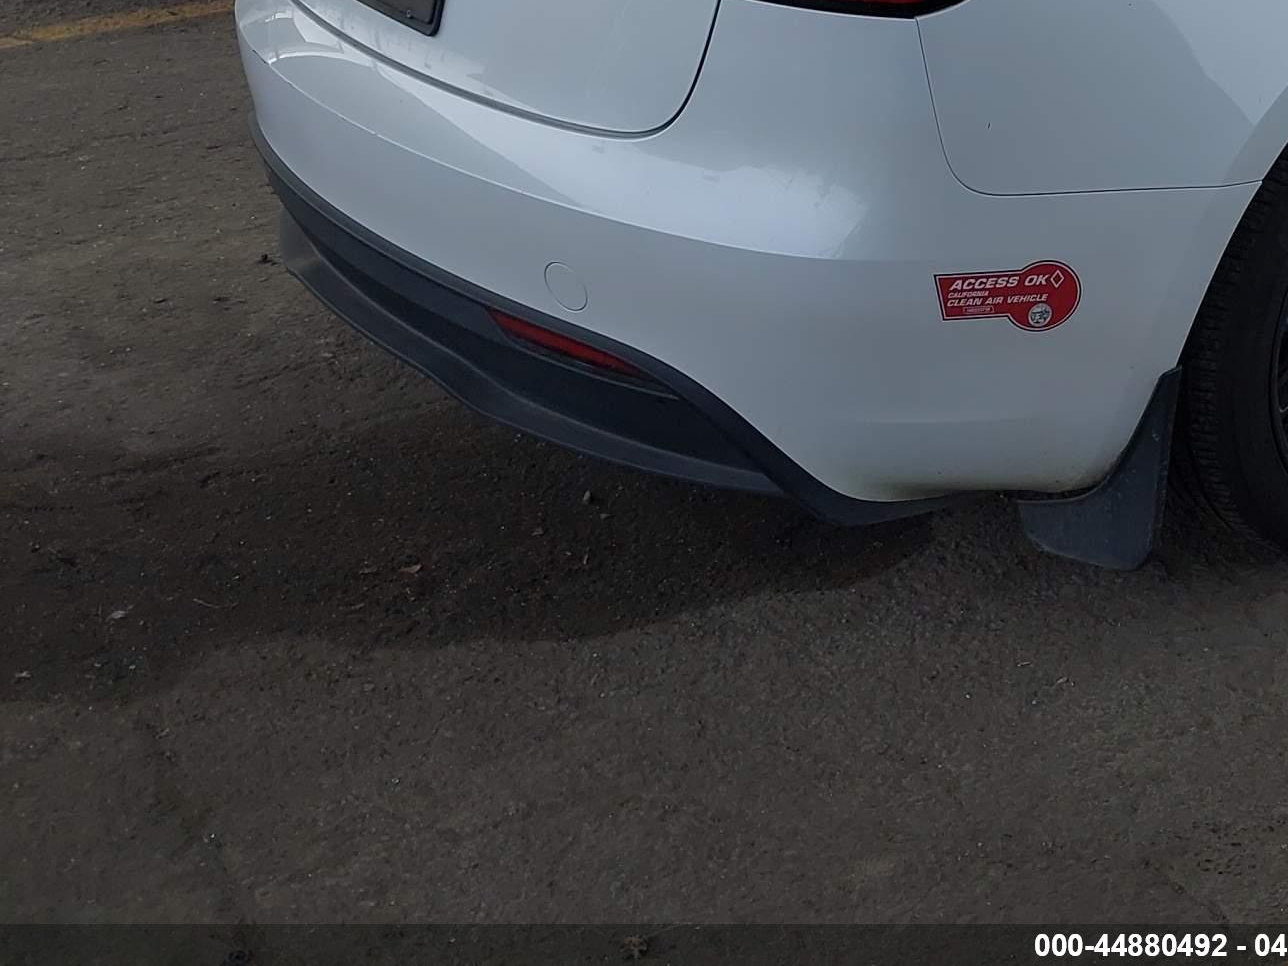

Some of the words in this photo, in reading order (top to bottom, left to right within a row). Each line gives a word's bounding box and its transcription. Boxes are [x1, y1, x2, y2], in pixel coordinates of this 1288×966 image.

[948, 276, 1020, 291] ACCESS
[1024, 273, 1050, 286] OK
[946, 297, 983, 307] CLEAN
[984, 295, 1004, 305] AIR
[1006, 293, 1049, 304] VEHICLE
[947, 290, 990, 299] CALIFORNIA
